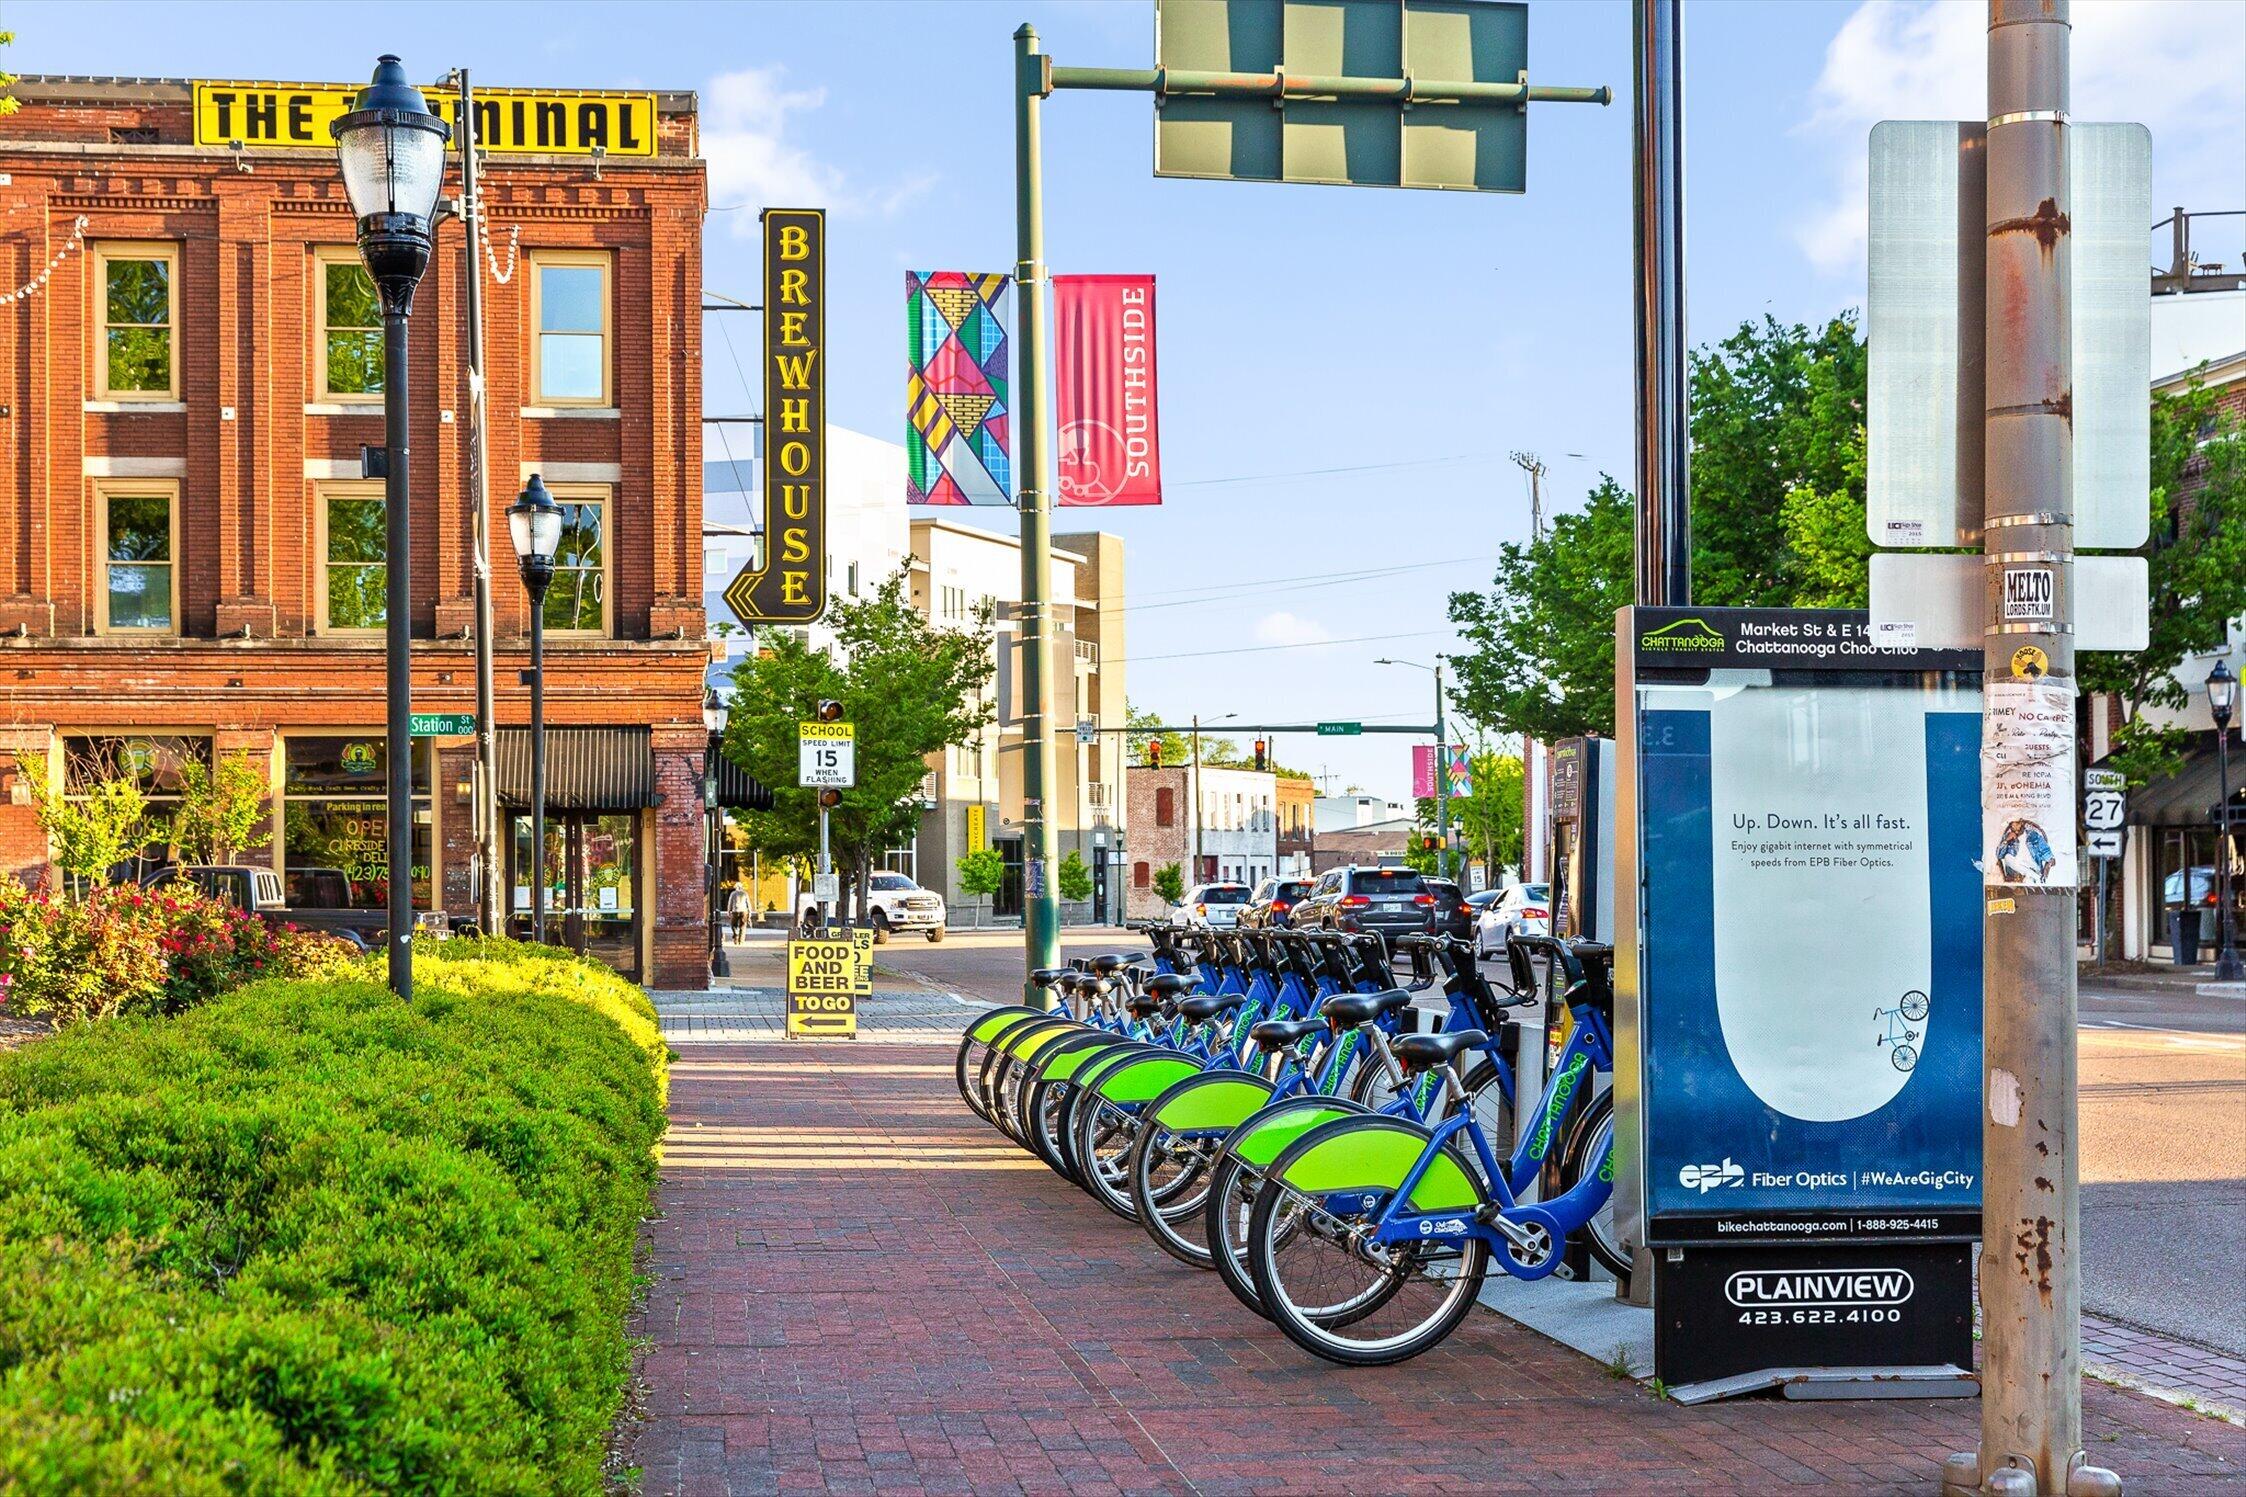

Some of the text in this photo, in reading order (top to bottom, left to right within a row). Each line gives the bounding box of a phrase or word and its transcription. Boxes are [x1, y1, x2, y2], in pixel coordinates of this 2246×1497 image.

[211, 92, 313, 142] THE
[1122, 286, 1150, 479] SOUTHSIDE
[775, 225, 818, 607] BREWHOUSE
[2007, 572, 2051, 603] MELTO
[1740, 622, 1799, 636] Market
[1803, 623, 1822, 637] St
[1826, 624, 1837, 636] &
[1842, 625, 1852, 637] E
[1641, 635, 1725, 648] CHATTANOOGA
[1736, 640, 1836, 658] Chattanooga
[1840, 641, 1878, 655] Choo
[411, 715, 471, 735] Station St
[802, 725, 852, 737] SCHOOL
[1324, 725, 1344, 733] MAIN
[802, 739, 851, 748] SPEED LIMIT
[816, 749, 838, 767] 15
[806, 775, 848, 784] FLASHING
[326, 802, 361, 812] Parking
[363, 802, 371, 811] in
[2088, 798, 2121, 821] 27
[1733, 813, 1910, 834] Up. Down. It's all fast.
[1731, 841, 1913, 854] Enjoy gigabit internet with symmetrical
[1750, 857, 1894, 869] speeds from EPB Fiber Optics.
[794, 946, 849, 960] FOOD
[801, 961, 843, 975] AND
[795, 976, 849, 990] BEER
[1752, 1172, 1792, 1187] Fiber
[1795, 1171, 1848, 1190] Optics
[1861, 1169, 1975, 1190] #WeAreGigCity
[1717, 1219, 1939, 1233] bikechattanooga.com 1-888-925-4415
[1736, 1275, 1904, 1300] PLAINVIEW
[1738, 1309, 1901, 1325] 423.622.4100
